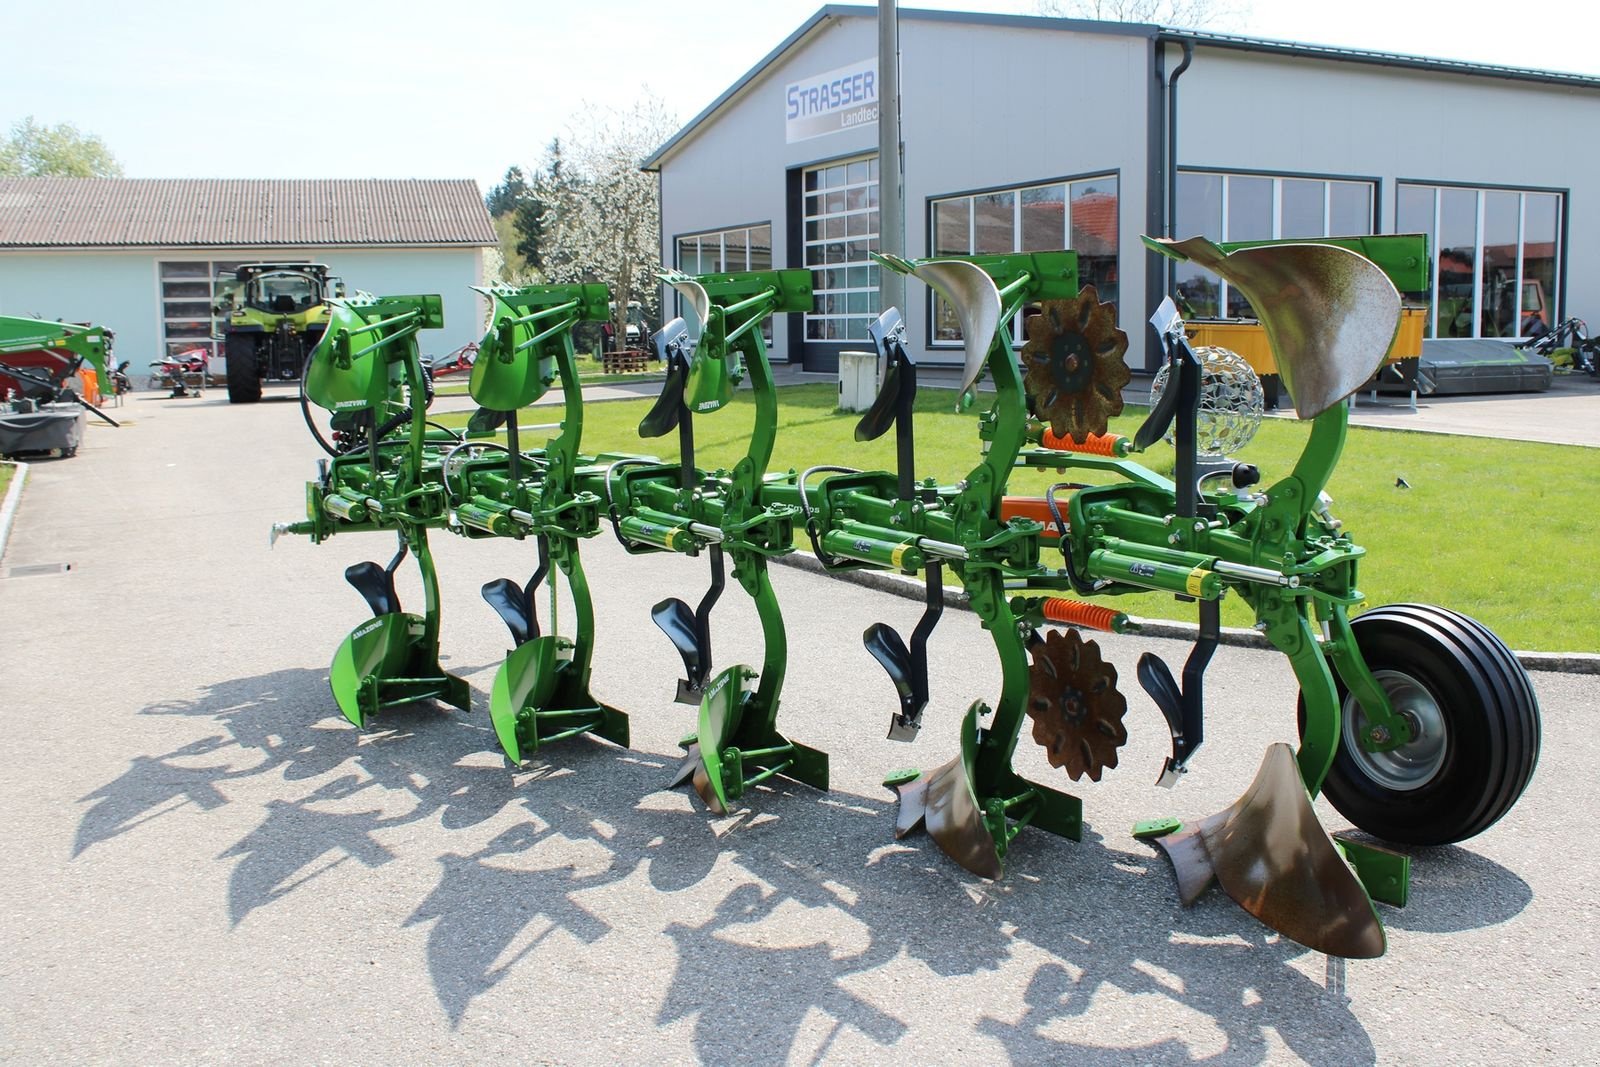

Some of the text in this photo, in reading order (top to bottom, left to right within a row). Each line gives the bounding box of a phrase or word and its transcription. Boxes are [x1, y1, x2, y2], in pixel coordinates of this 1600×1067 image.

[787, 70, 875, 121] STRASSER
[352, 619, 384, 641] AMAZONE
[708, 672, 730, 701] AMAZONE
